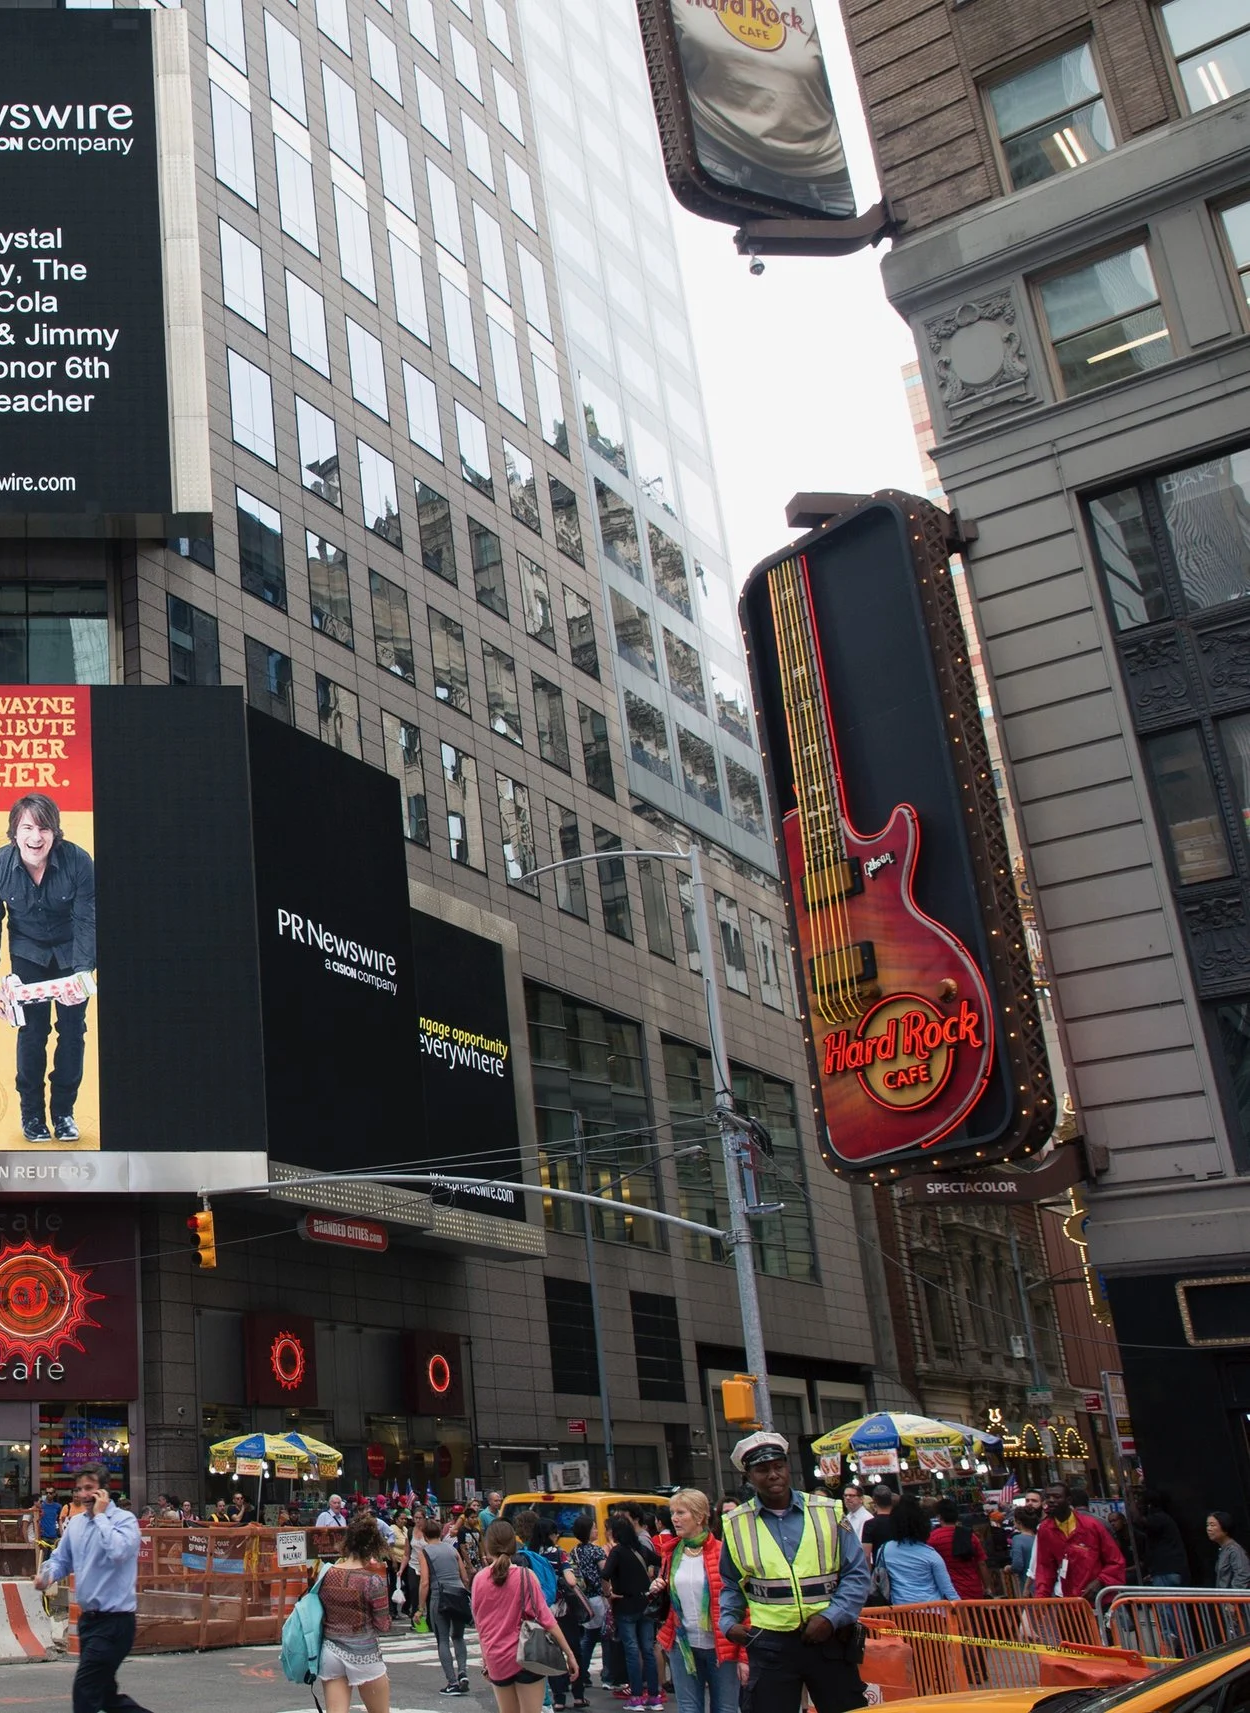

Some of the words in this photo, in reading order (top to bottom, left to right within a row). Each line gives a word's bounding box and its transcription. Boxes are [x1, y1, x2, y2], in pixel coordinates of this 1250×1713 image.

[750, 0, 808, 35] Rock
[739, 25, 771, 40] CAFE
[27, 137, 135, 155] company
[32, 259, 88, 281] The
[24, 323, 120, 351] Jimmy
[64, 356, 110, 379] 6th
[863, 852, 897, 878] Gibson
[277, 908, 306, 944] PR
[306, 918, 397, 976] Newswire
[324, 958, 332, 970] a
[331, 961, 358, 979] CISION
[357, 970, 398, 996] company
[419, 1016, 450, 1040] ngage
[451, 1027, 509, 1060] opportunity
[823, 1018, 898, 1075] Hard
[900, 1000, 984, 1061] Rock
[882, 1063, 932, 1090] CAFE
[14, 1165, 90, 1179] REUTERS
[925, 1181, 1019, 1195] SPECTACOLOR
[313, 1219, 348, 1239] BRANDED
[347, 1226, 383, 1244] CITIES.com
[914, 1436, 951, 1445] SABRETT
[279, 1534, 306, 1544] PEDESTRIAN
[282, 1552, 304, 1561] WALKWAY
[753, 1585, 768, 1597] NY
[919, 1631, 948, 1642] CAUTION
[961, 1635, 993, 1647] CAUTION
[998, 1638, 1031, 1650] CAUTION
